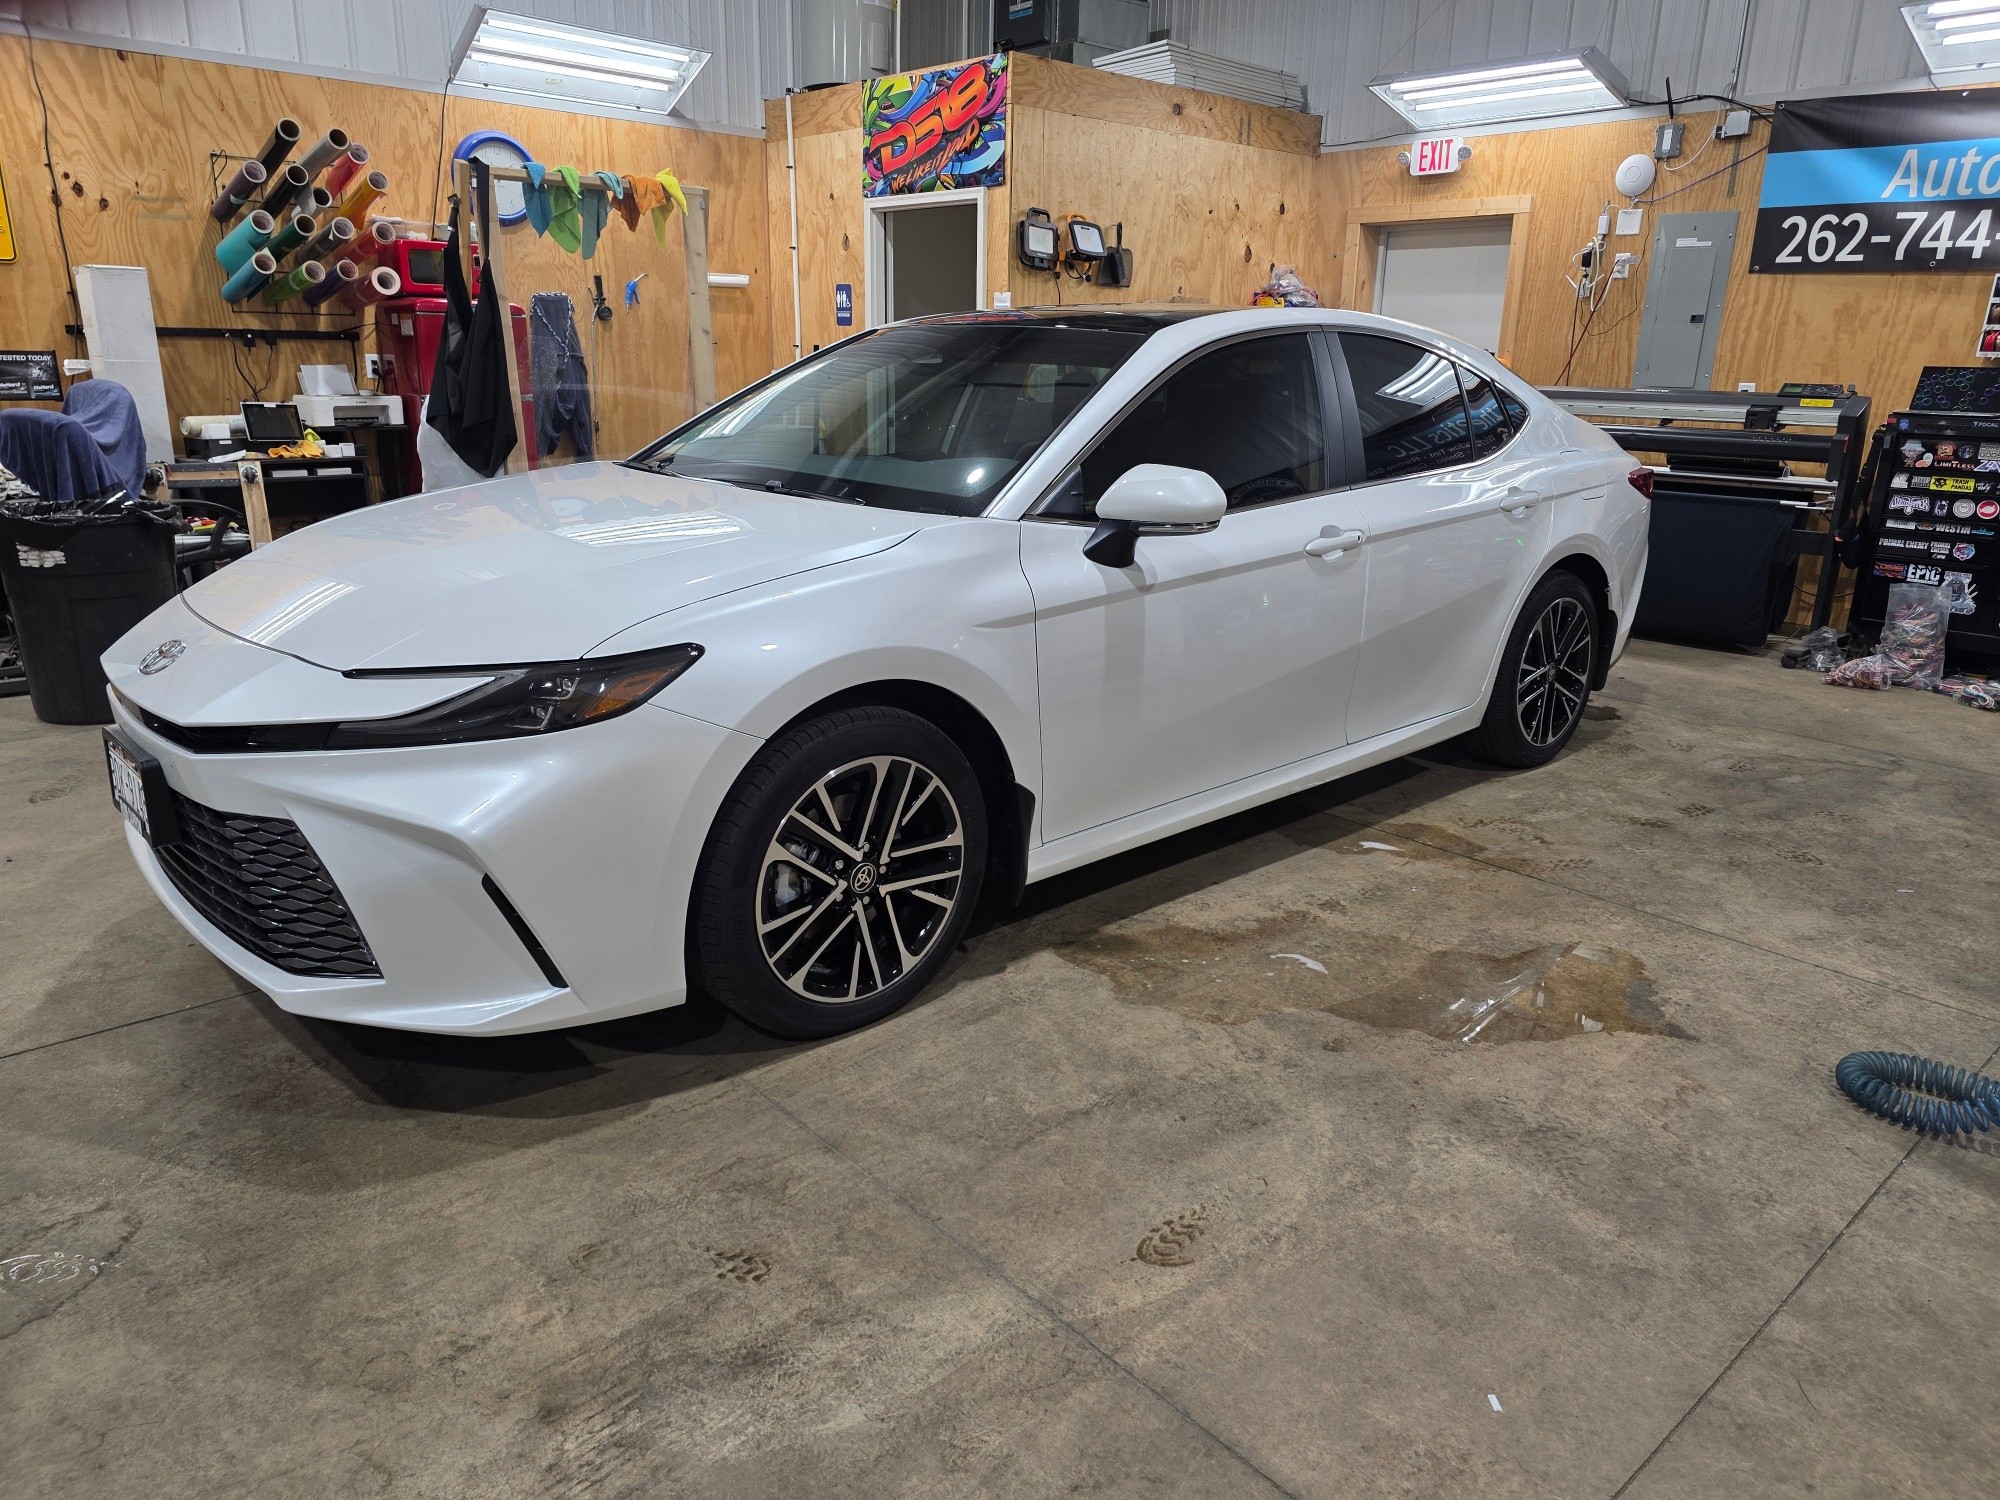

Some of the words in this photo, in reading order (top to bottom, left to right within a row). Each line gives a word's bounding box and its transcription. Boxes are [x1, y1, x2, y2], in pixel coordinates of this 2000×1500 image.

[869, 63, 989, 175] DS18
[1418, 138, 1454, 173] EXIT
[1880, 146, 2000, 199] Auto
[1774, 209, 2000, 264] 262-744
[27, 354, 52, 362] TODAY
[1907, 563, 1942, 581] EPIC
